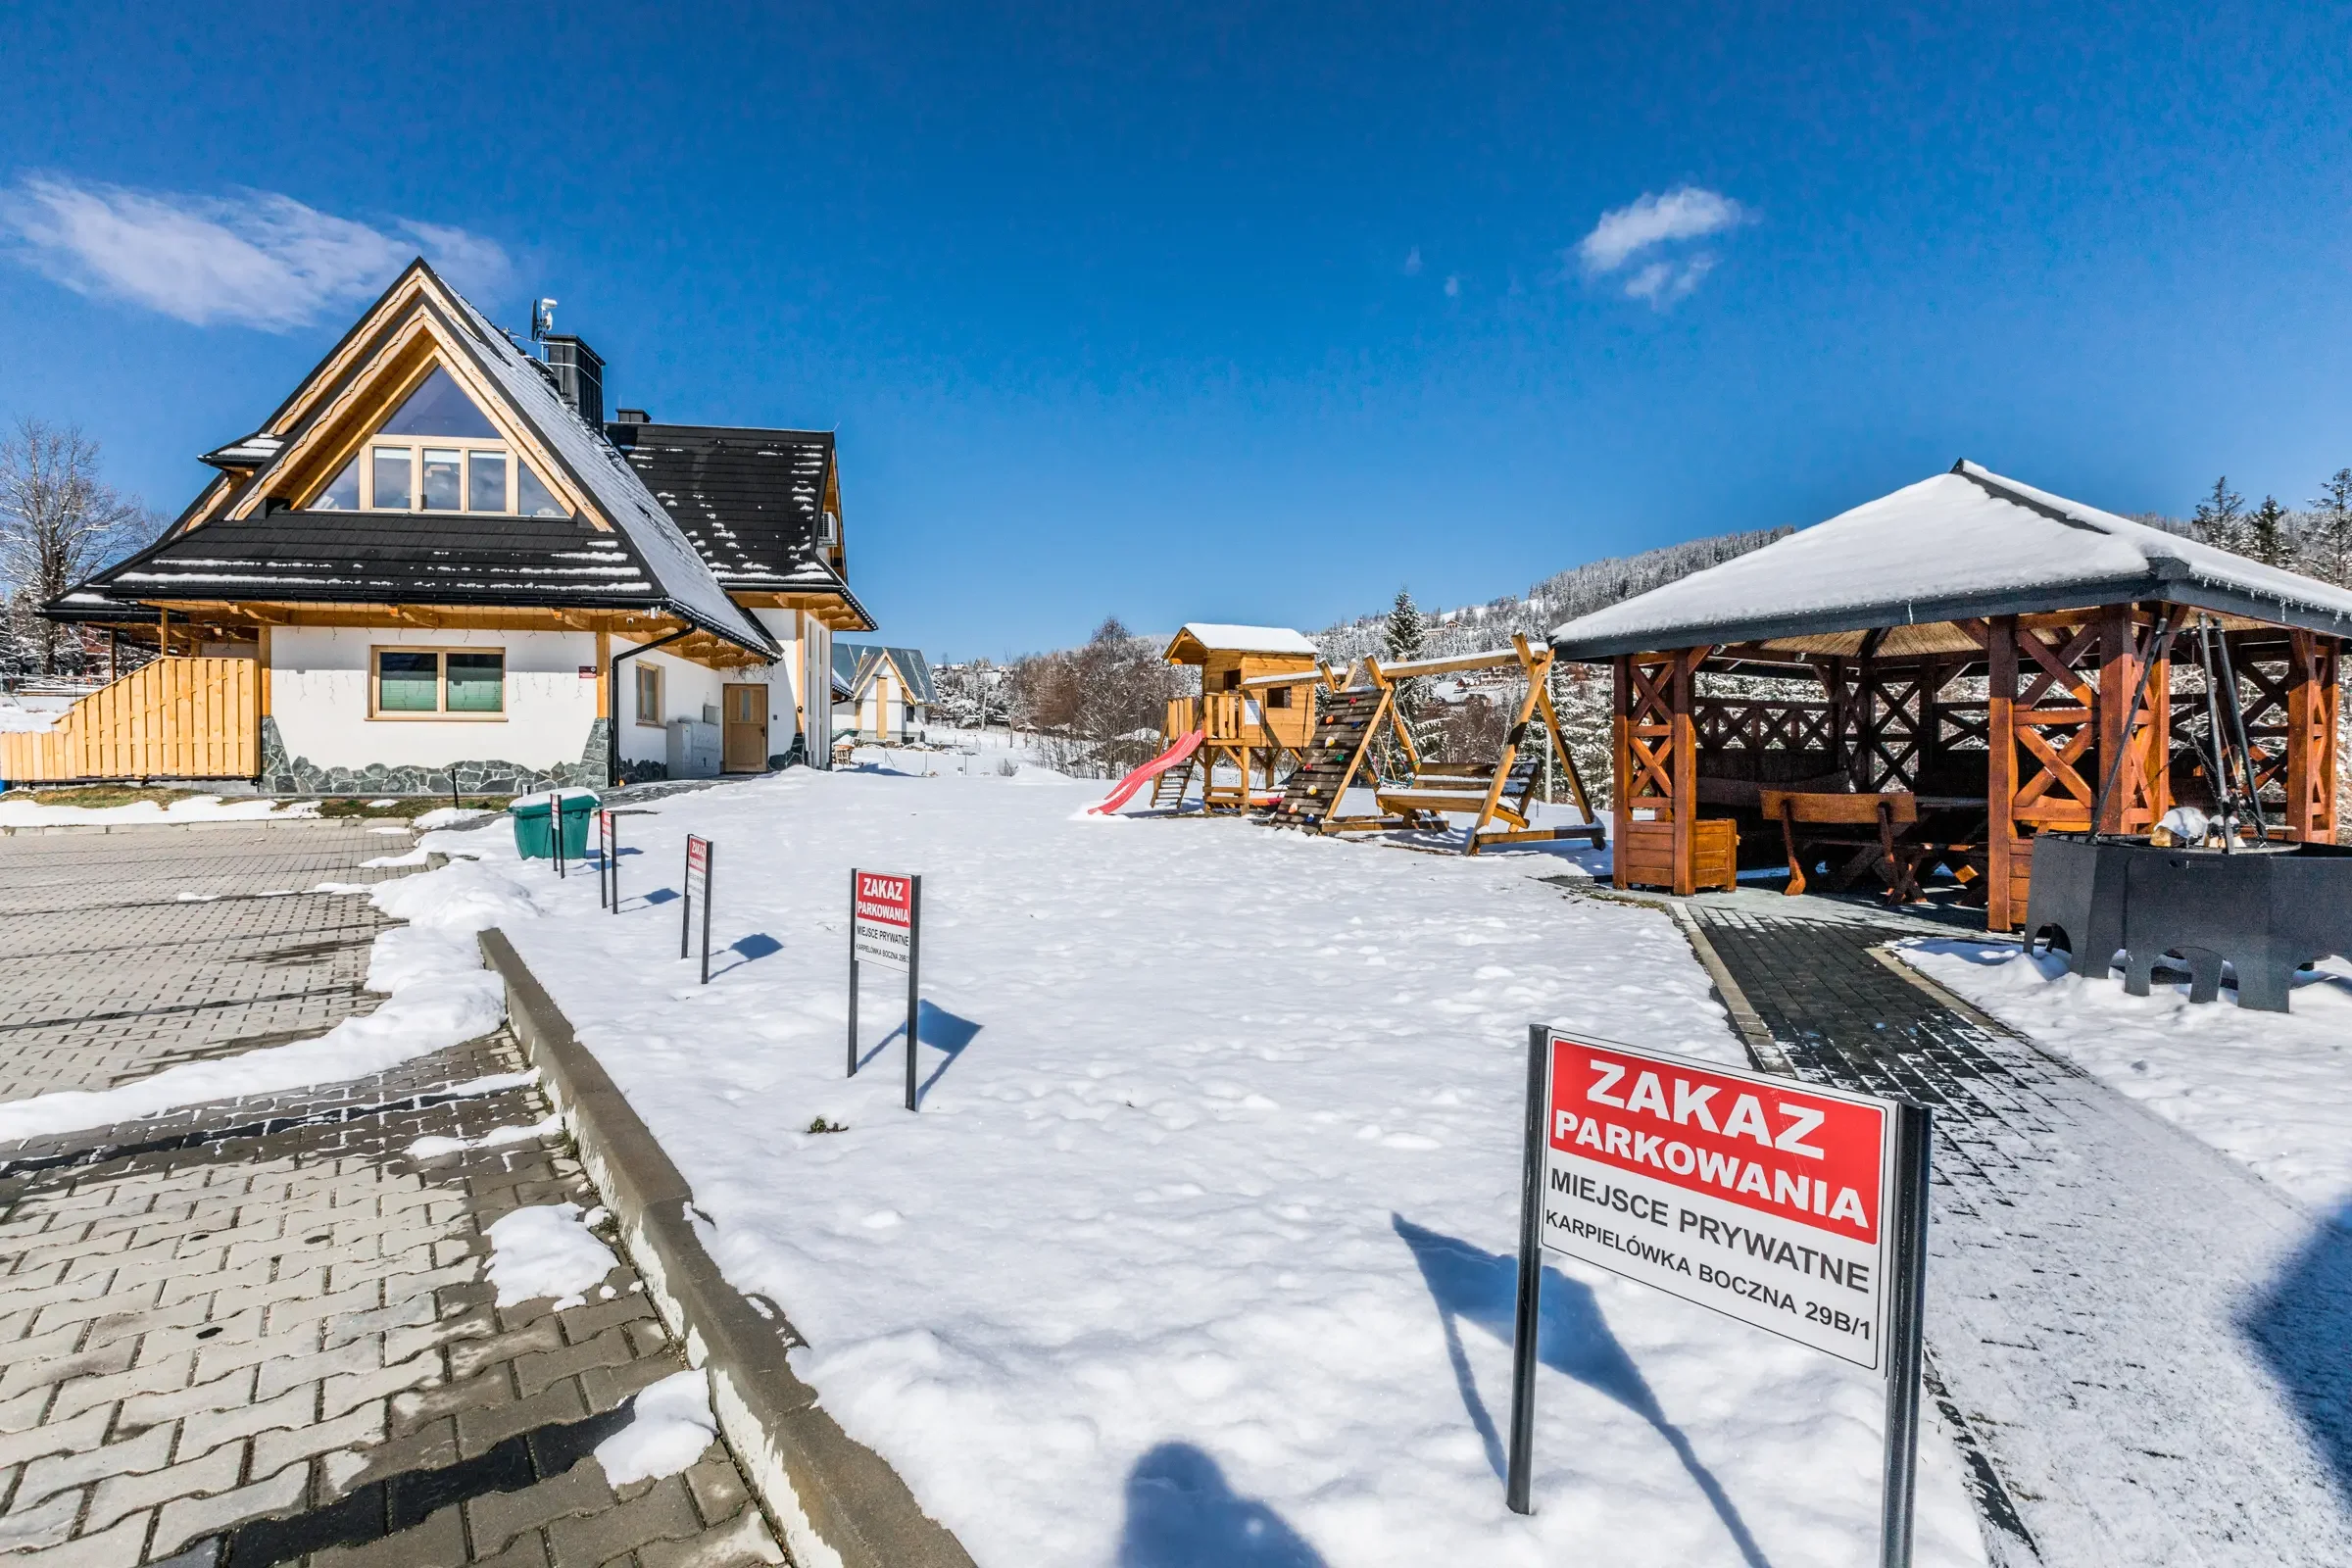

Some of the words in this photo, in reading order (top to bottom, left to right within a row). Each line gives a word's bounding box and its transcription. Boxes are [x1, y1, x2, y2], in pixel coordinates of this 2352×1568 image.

[858, 901, 909, 923] PARKOWANIA
[863, 878, 903, 901] ZAKAZ
[857, 925, 878, 940] MIEJSCE
[879, 930, 909, 947] PRYWATNE
[882, 950, 899, 960] BOCZNA
[1587, 1058, 1826, 1160] ZAKAZ
[1555, 1109, 1869, 1229] PARKOWANIA
[1550, 1167, 1669, 1227] MIEJSCE
[1679, 1208, 1870, 1294] PRYWATNE
[1545, 1209, 1691, 1276] KARPIELÓWKA
[1698, 1263, 1797, 1314] BOCZNA
[1804, 1301, 1871, 1340] 29B/1
